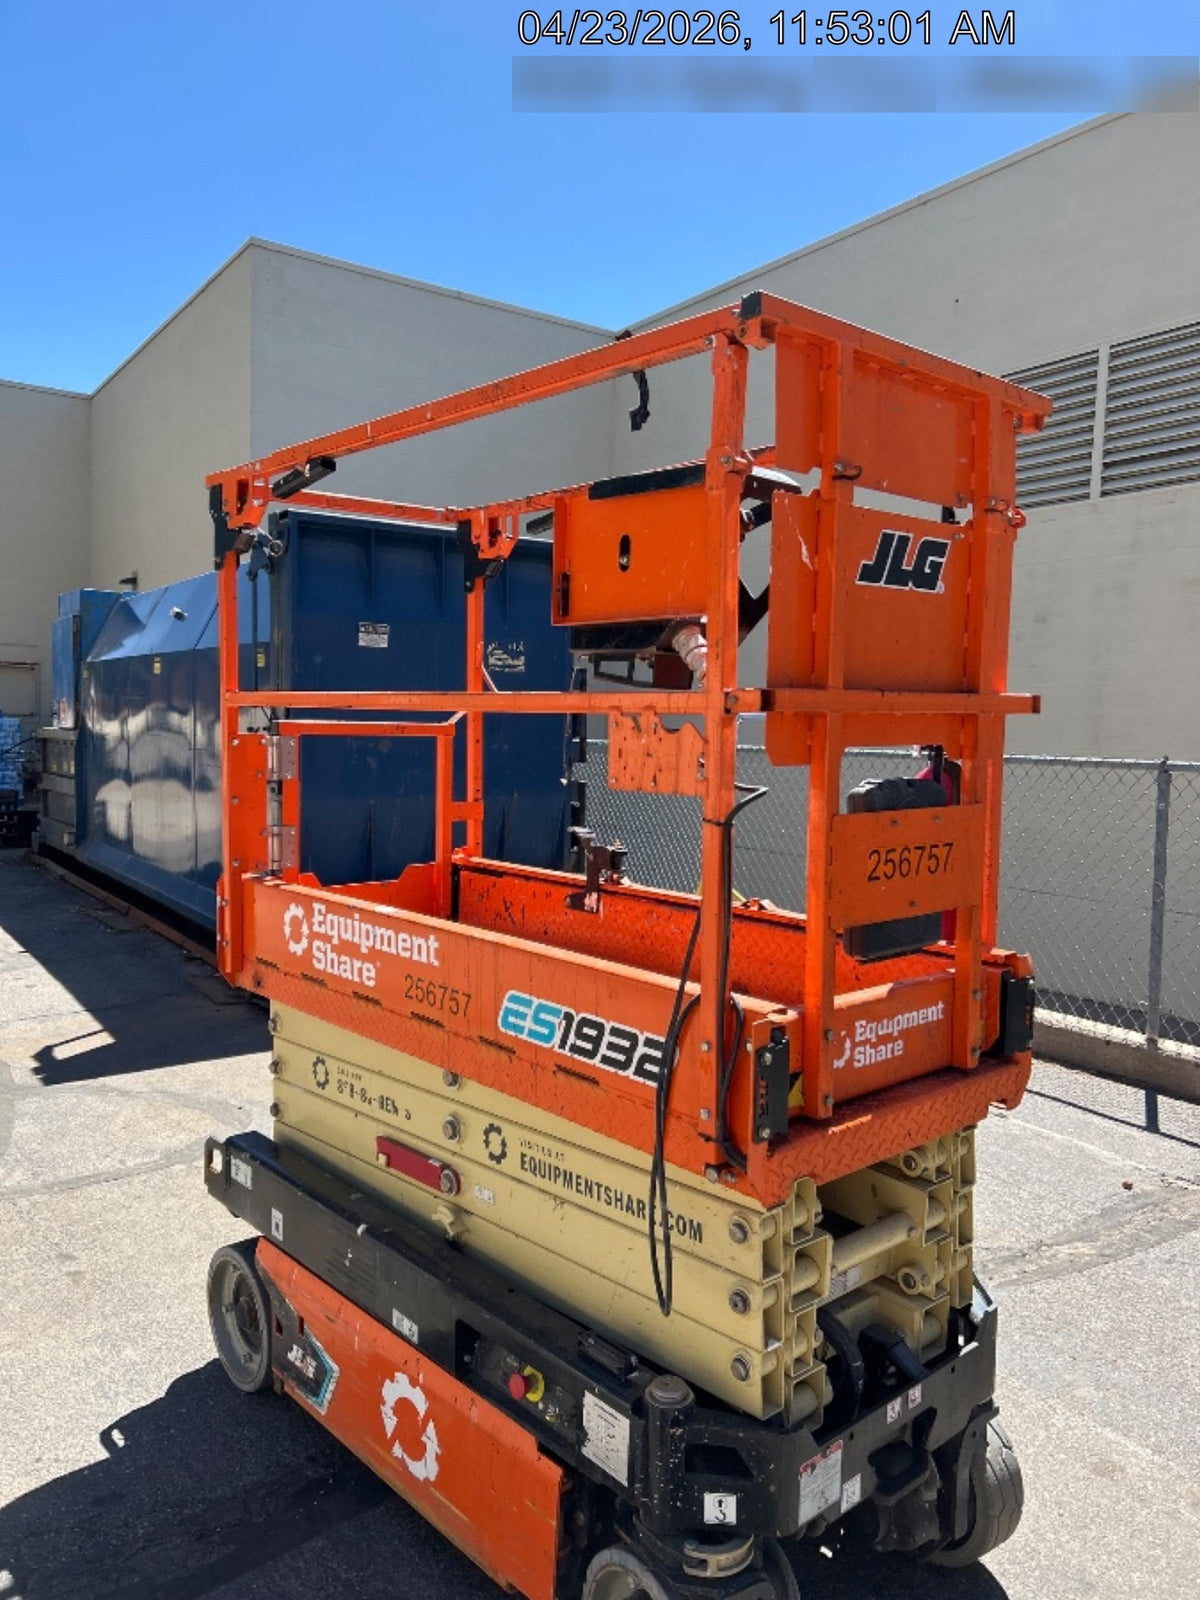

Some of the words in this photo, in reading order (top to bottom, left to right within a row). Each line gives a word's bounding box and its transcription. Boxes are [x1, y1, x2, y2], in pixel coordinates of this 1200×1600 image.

[855, 529, 951, 593] JLG
[867, 842, 954, 882] 256757
[312, 902, 440, 967] Equipment
[312, 940, 376, 987] Share
[404, 974, 472, 1018] 256757
[498, 990, 674, 1087] ES1932
[854, 1001, 944, 1044] Equipment
[853, 1039, 904, 1068] Share
[520, 1152, 704, 1244] EQUIPMENTSHAR.COM
